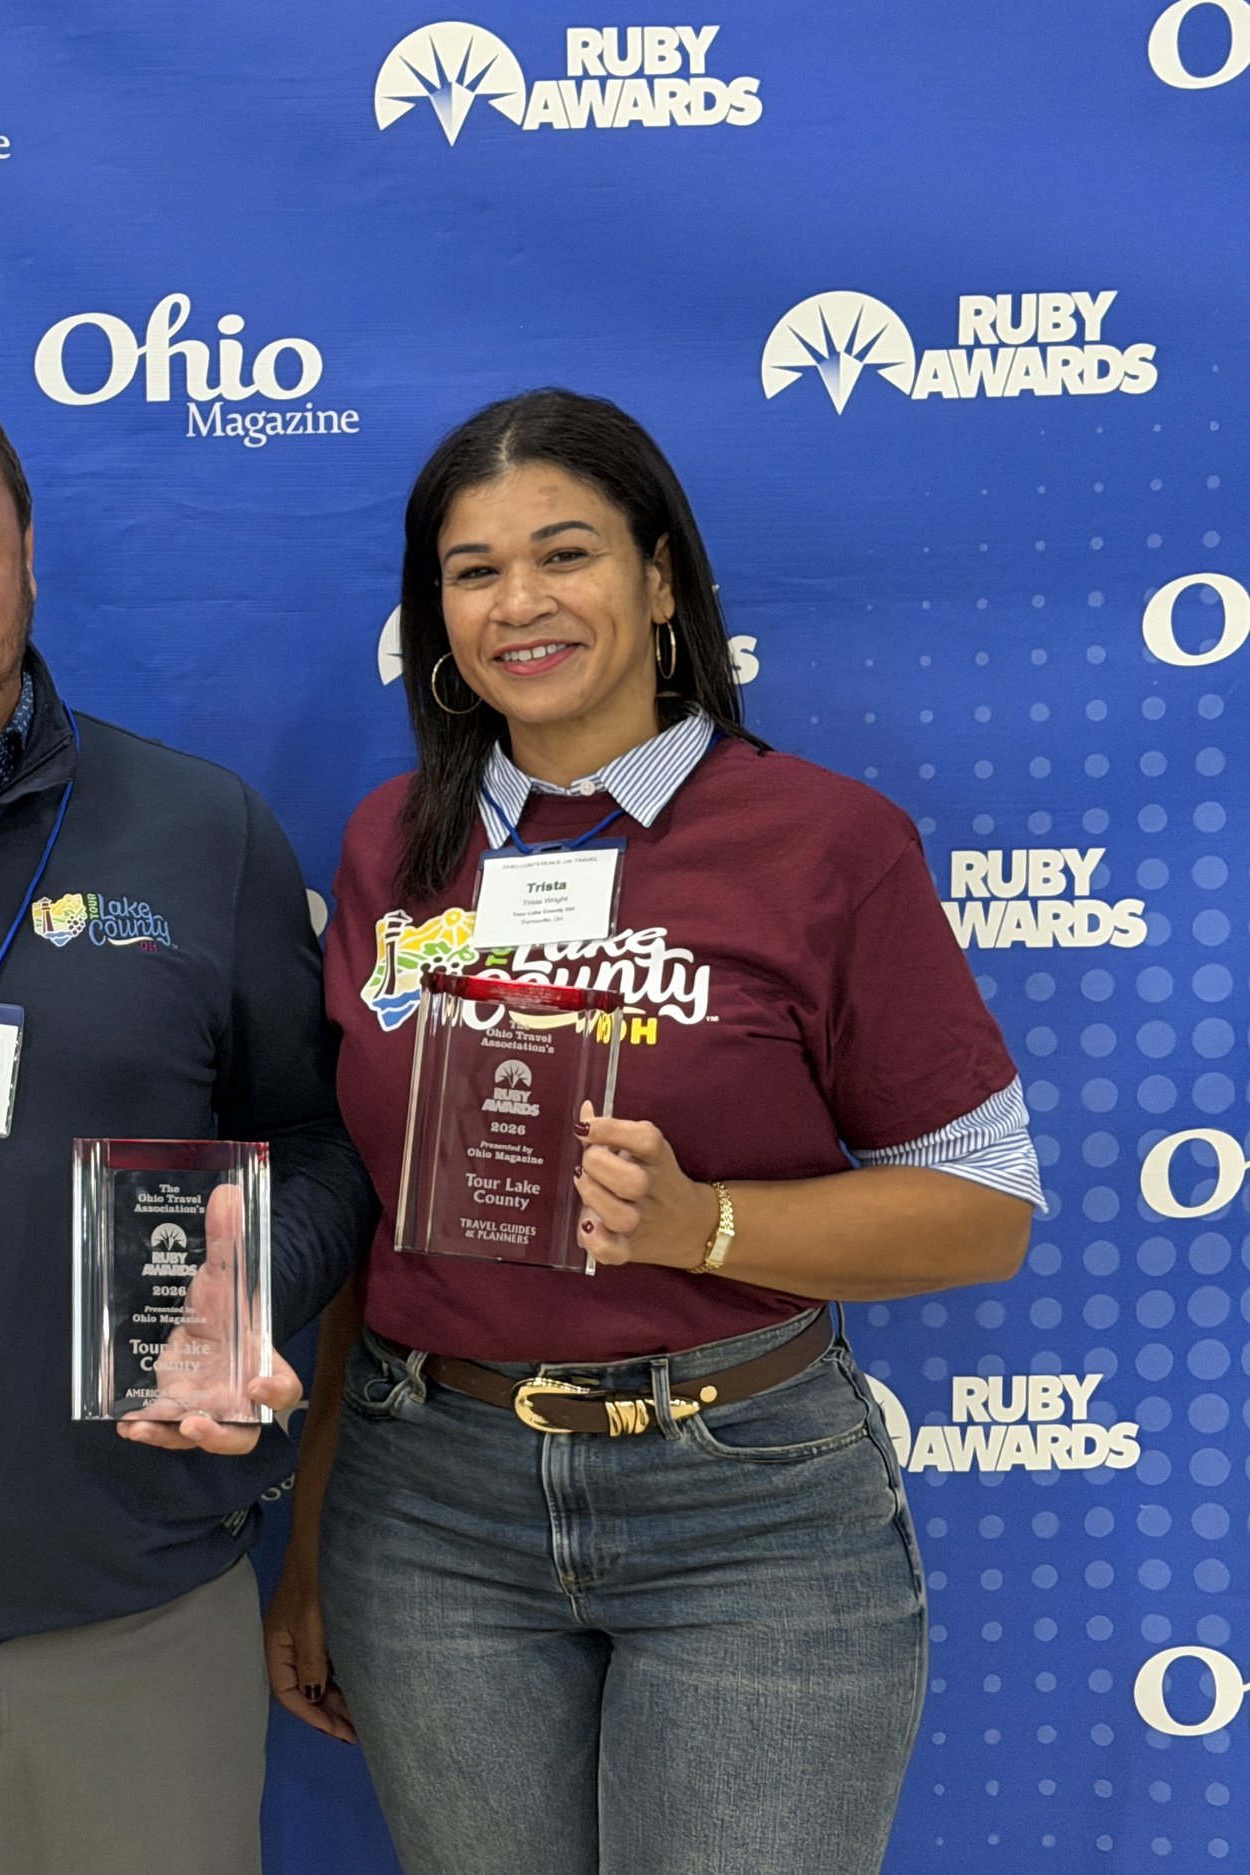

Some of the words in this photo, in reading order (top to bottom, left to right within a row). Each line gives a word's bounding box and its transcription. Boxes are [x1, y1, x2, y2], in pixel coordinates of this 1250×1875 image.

[567, 25, 720, 77] RUBY
[523, 77, 762, 131] AWARDS
[958, 291, 1118, 345] RUBY
[34, 293, 323, 406] Ohio
[911, 343, 1157, 400] AWARDS
[186, 402, 360, 448] Magazine
[951, 848, 1106, 899] RUBY
[527, 880, 567, 893] Trista
[87, 893, 99, 919] TOUR
[97, 893, 152, 921] Lake
[89, 912, 170, 946] County
[940, 898, 1148, 949] WARDS
[485, 1027, 513, 1039] Ohio
[515, 1030, 552, 1043] Travel
[481, 1037, 555, 1054] Association's
[493, 1087, 532, 1103] RUBY
[481, 1098, 540, 1117] AWARDS
[490, 1121, 526, 1136] 2026
[467, 1147, 492, 1159] Ohio
[494, 1151, 544, 1165] Magazine
[480, 1140, 521, 1152] Presented
[522, 1145, 533, 1154] by
[159, 1184, 180, 1193] The
[465, 1172, 501, 1190] Tour
[505, 1177, 541, 1195] Lake
[137, 1193, 164, 1203] Ohio
[166, 1194, 202, 1204] Travel
[473, 1189, 530, 1211] County
[133, 1203, 205, 1214] Association's
[460, 1217, 497, 1232] TRAVEL
[499, 1222, 537, 1236] GUIDES
[465, 1229, 475, 1238] &
[477, 1230, 529, 1245] PLANNERS
[151, 1251, 188, 1264] RUBY
[141, 1263, 198, 1277] AWARDS
[152, 1285, 187, 1297] 2026
[132, 1313, 157, 1323] Ohio
[952, 1374, 1104, 1423] RUBY
[907, 1420, 1141, 1473] AWARDS
